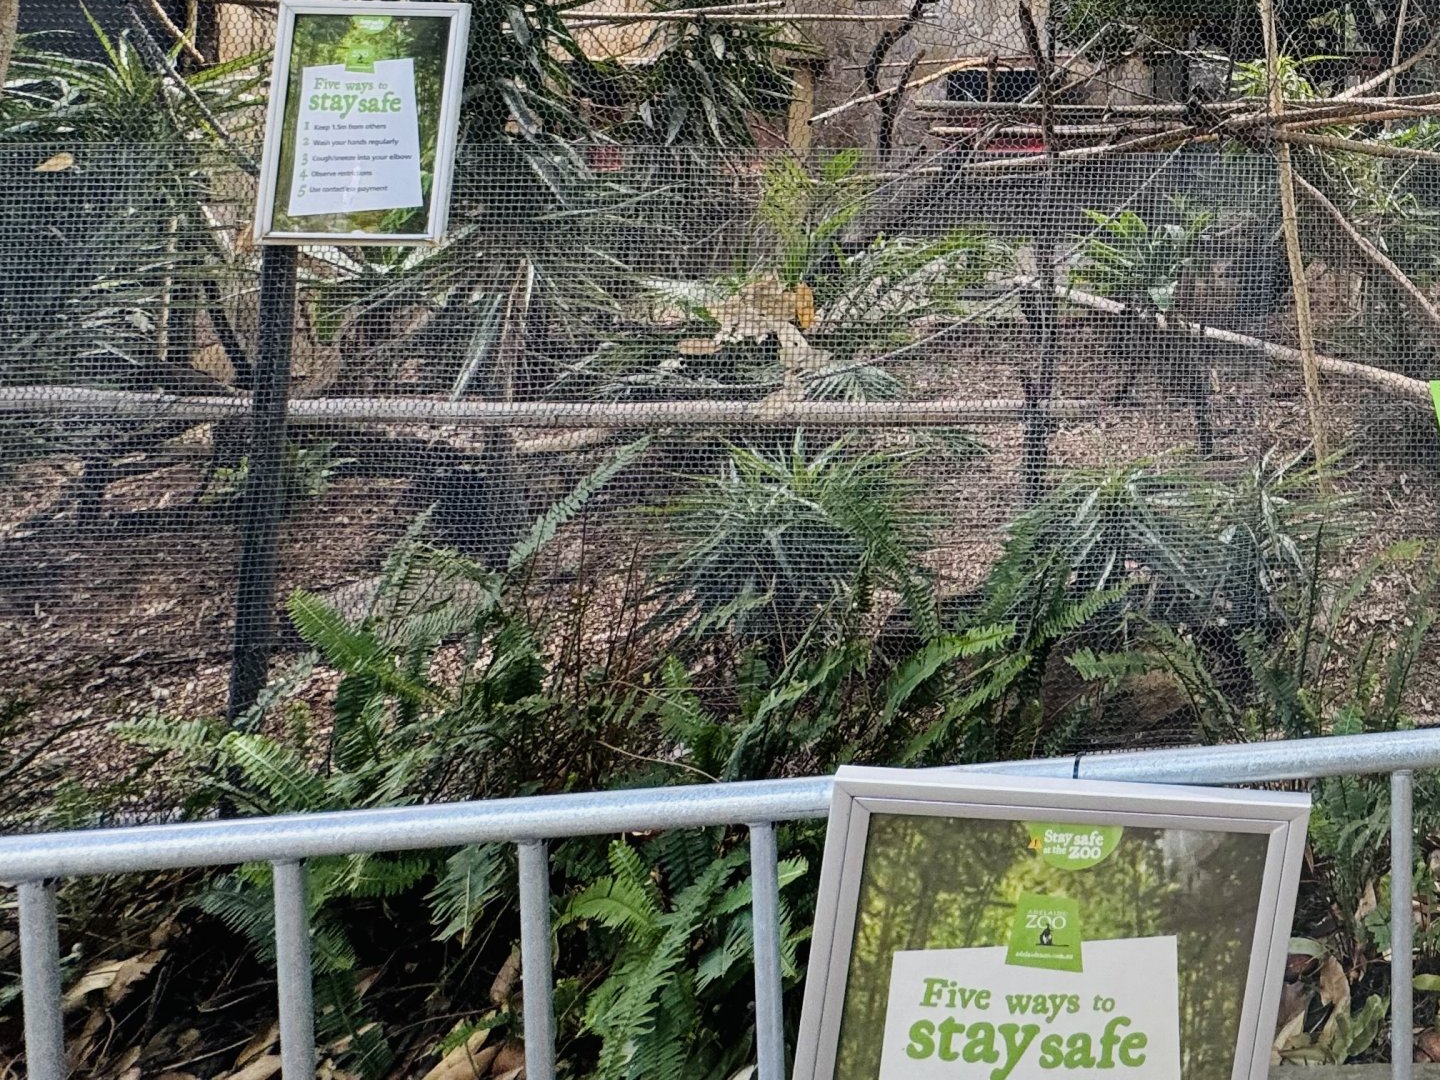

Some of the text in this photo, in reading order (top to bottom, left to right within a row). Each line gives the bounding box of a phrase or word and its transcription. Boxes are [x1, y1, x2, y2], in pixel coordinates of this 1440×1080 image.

[314, 77, 388, 94] Five ways to
[308, 91, 402, 119] stay safe
[302, 137, 310, 146] 2
[368, 138, 399, 146] regularly
[299, 169, 309, 181] 4
[297, 184, 307, 197] 5
[357, 185, 388, 193] payment
[1044, 830, 1104, 846] Stay safe
[1043, 846, 1052, 854] at
[1052, 845, 1067, 855] the
[1025, 914, 1066, 929] ZOO
[919, 977, 1115, 1024] Five ways to
[906, 1016, 1148, 1080] stay safe
